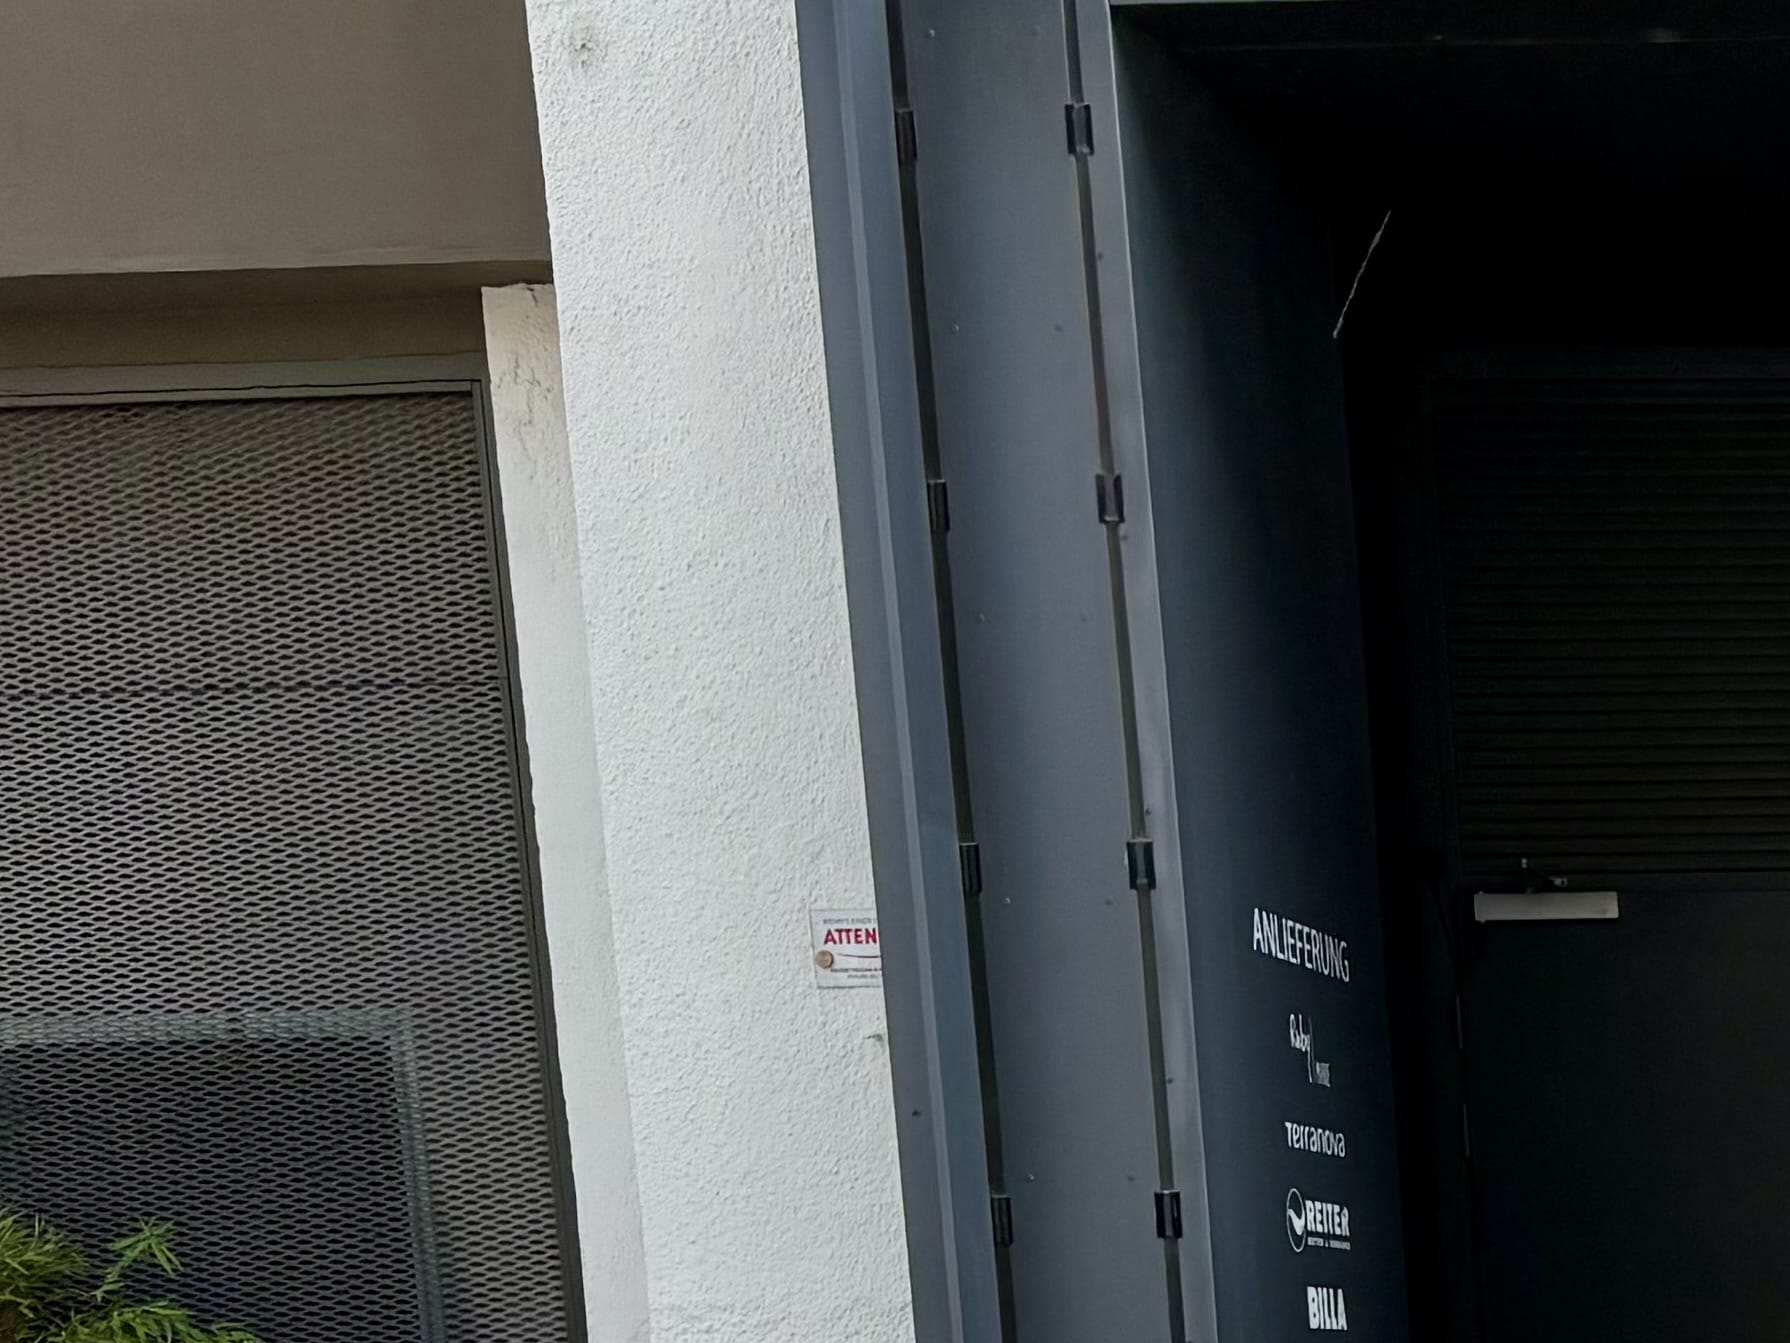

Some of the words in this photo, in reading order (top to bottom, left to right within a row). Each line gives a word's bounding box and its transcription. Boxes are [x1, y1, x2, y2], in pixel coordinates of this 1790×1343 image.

[1253, 907, 1350, 983] ANLIEFERUNG
[1305, 1200, 1351, 1236] REITER
[1307, 1286, 1349, 1330] BILLA
